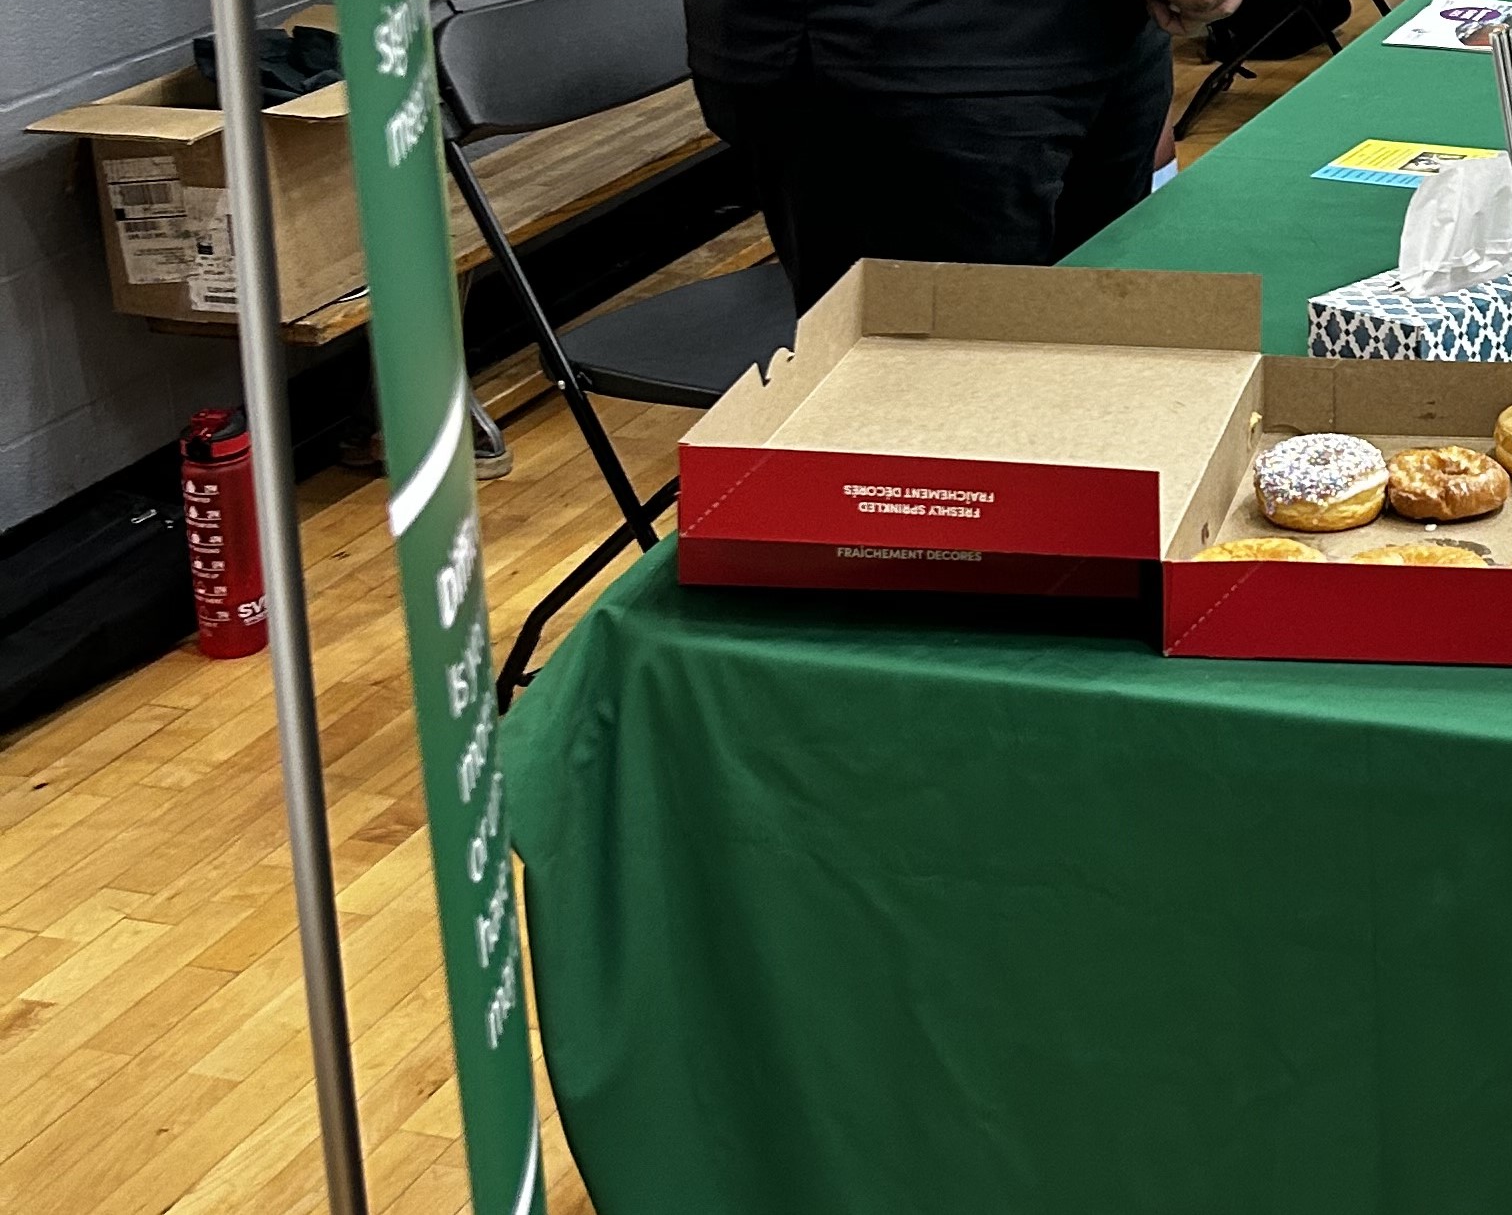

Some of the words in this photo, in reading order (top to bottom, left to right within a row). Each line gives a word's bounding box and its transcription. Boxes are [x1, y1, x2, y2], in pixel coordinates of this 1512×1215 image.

[903, 487, 995, 505] FRAÎCHEMENT
[858, 501, 927, 516] SPRINKLED
[928, 504, 981, 519] FRESHLY
